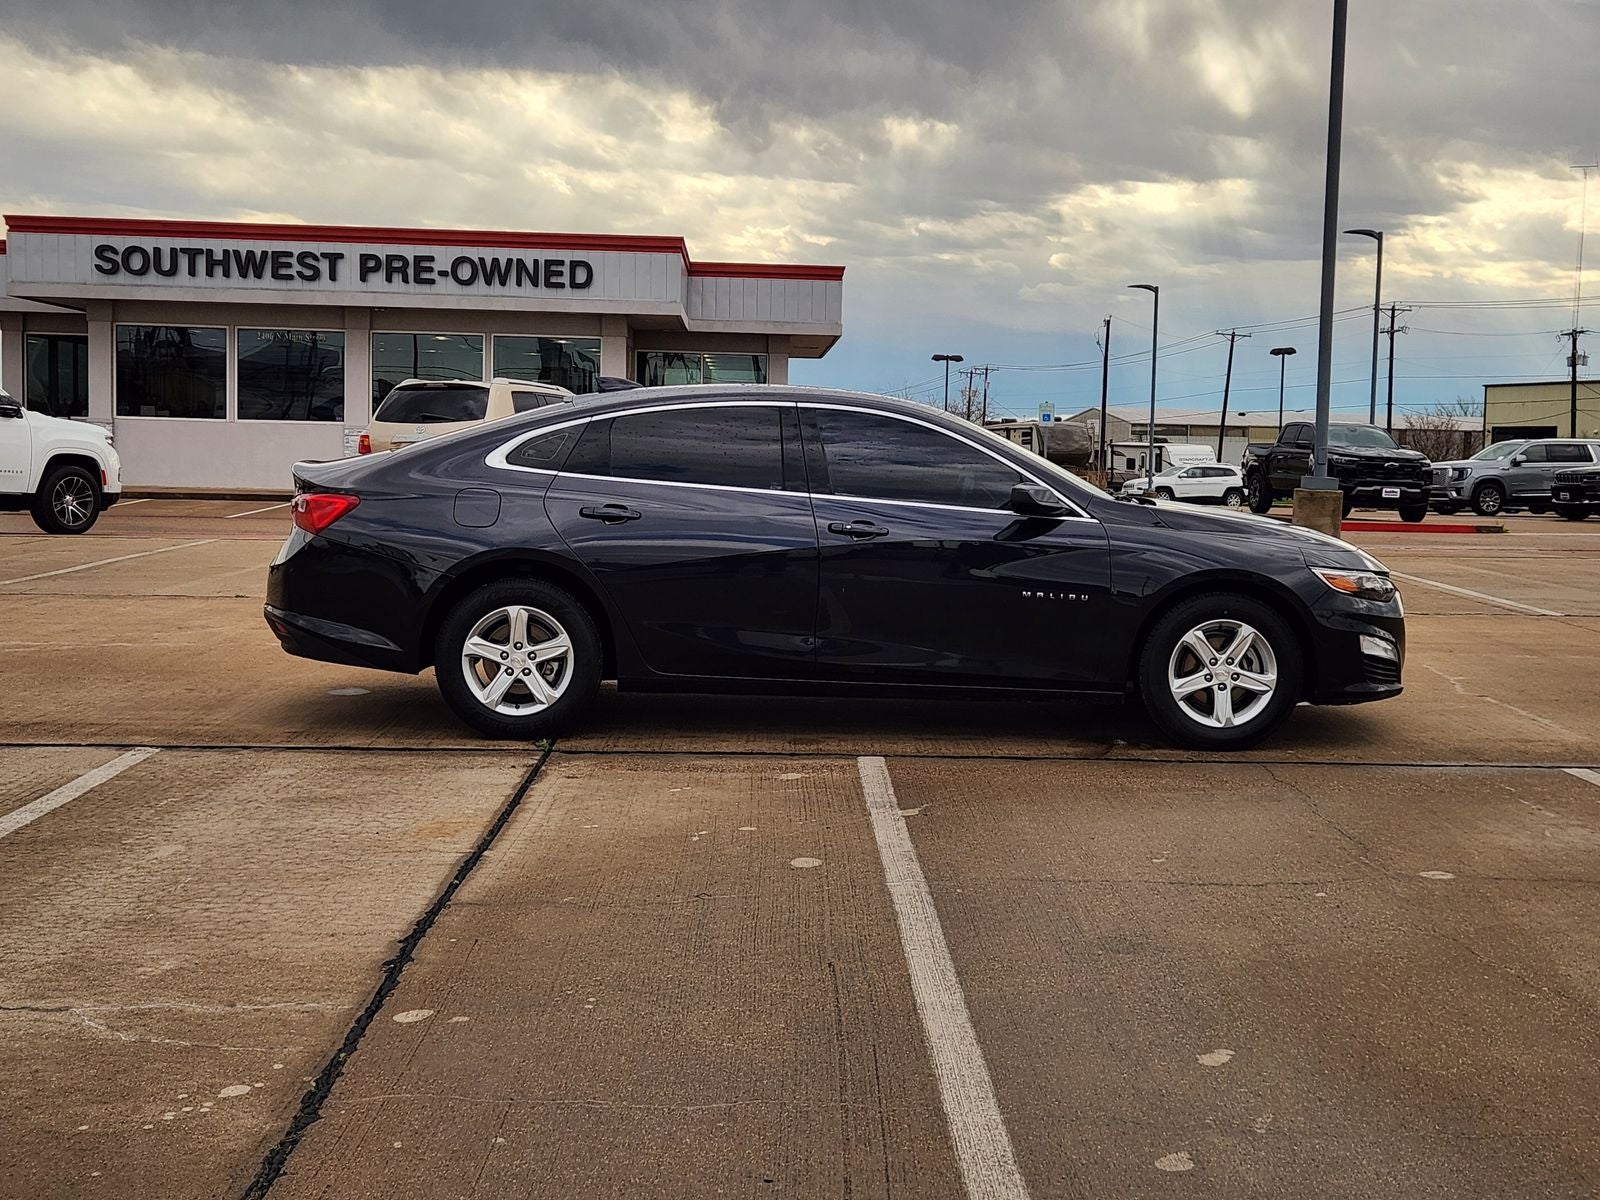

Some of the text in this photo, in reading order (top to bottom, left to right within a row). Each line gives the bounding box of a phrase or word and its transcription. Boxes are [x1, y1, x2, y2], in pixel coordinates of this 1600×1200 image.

[94, 244, 594, 289] SOUTHWEST PRE-OWNED
[285, 332, 303, 341] Main
[1022, 591, 1089, 601] MALIBU
